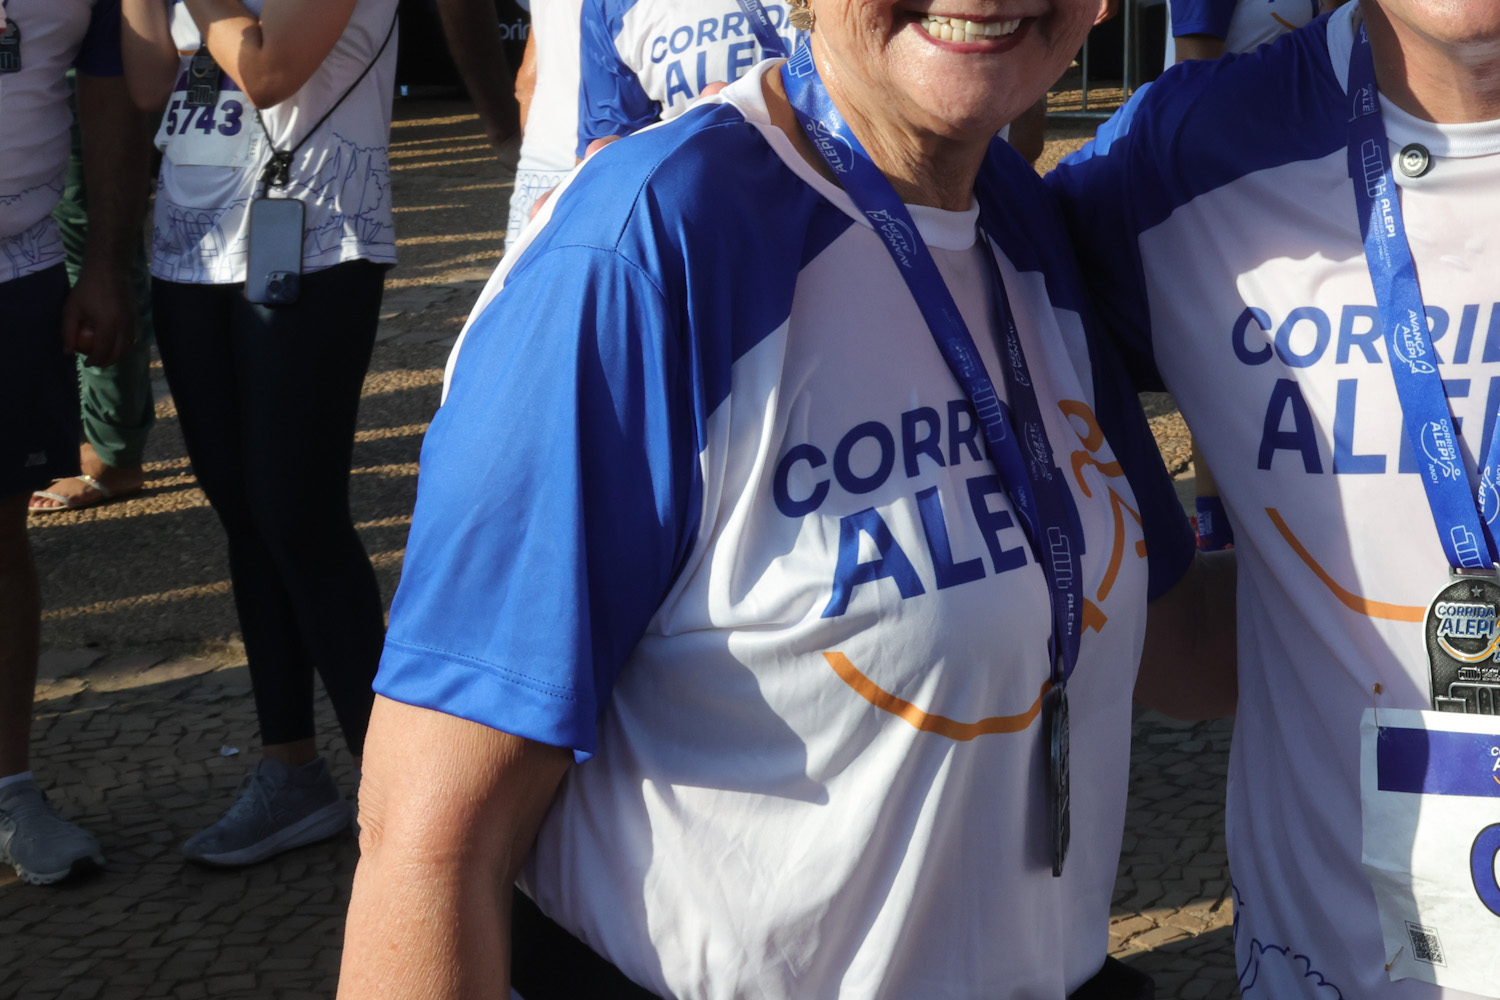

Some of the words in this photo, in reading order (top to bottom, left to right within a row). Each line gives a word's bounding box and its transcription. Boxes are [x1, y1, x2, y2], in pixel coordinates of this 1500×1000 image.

[166, 99, 244, 137] 5743
[1361, 87, 1371, 115] ALE
[1380, 198, 1397, 238] ALEPI
[880, 224, 912, 269] AVANÇA
[1401, 325, 1418, 359] ALEPI
[1407, 309, 1427, 357] AVANÇA
[773, 399, 984, 519] CORR
[1429, 420, 1451, 461] ALEPI
[1439, 418, 1457, 461] CORRIDA
[820, 474, 1028, 619] ALE
[1437, 604, 1496, 618] CORRIDA
[1440, 617, 1495, 636] ALEPI
